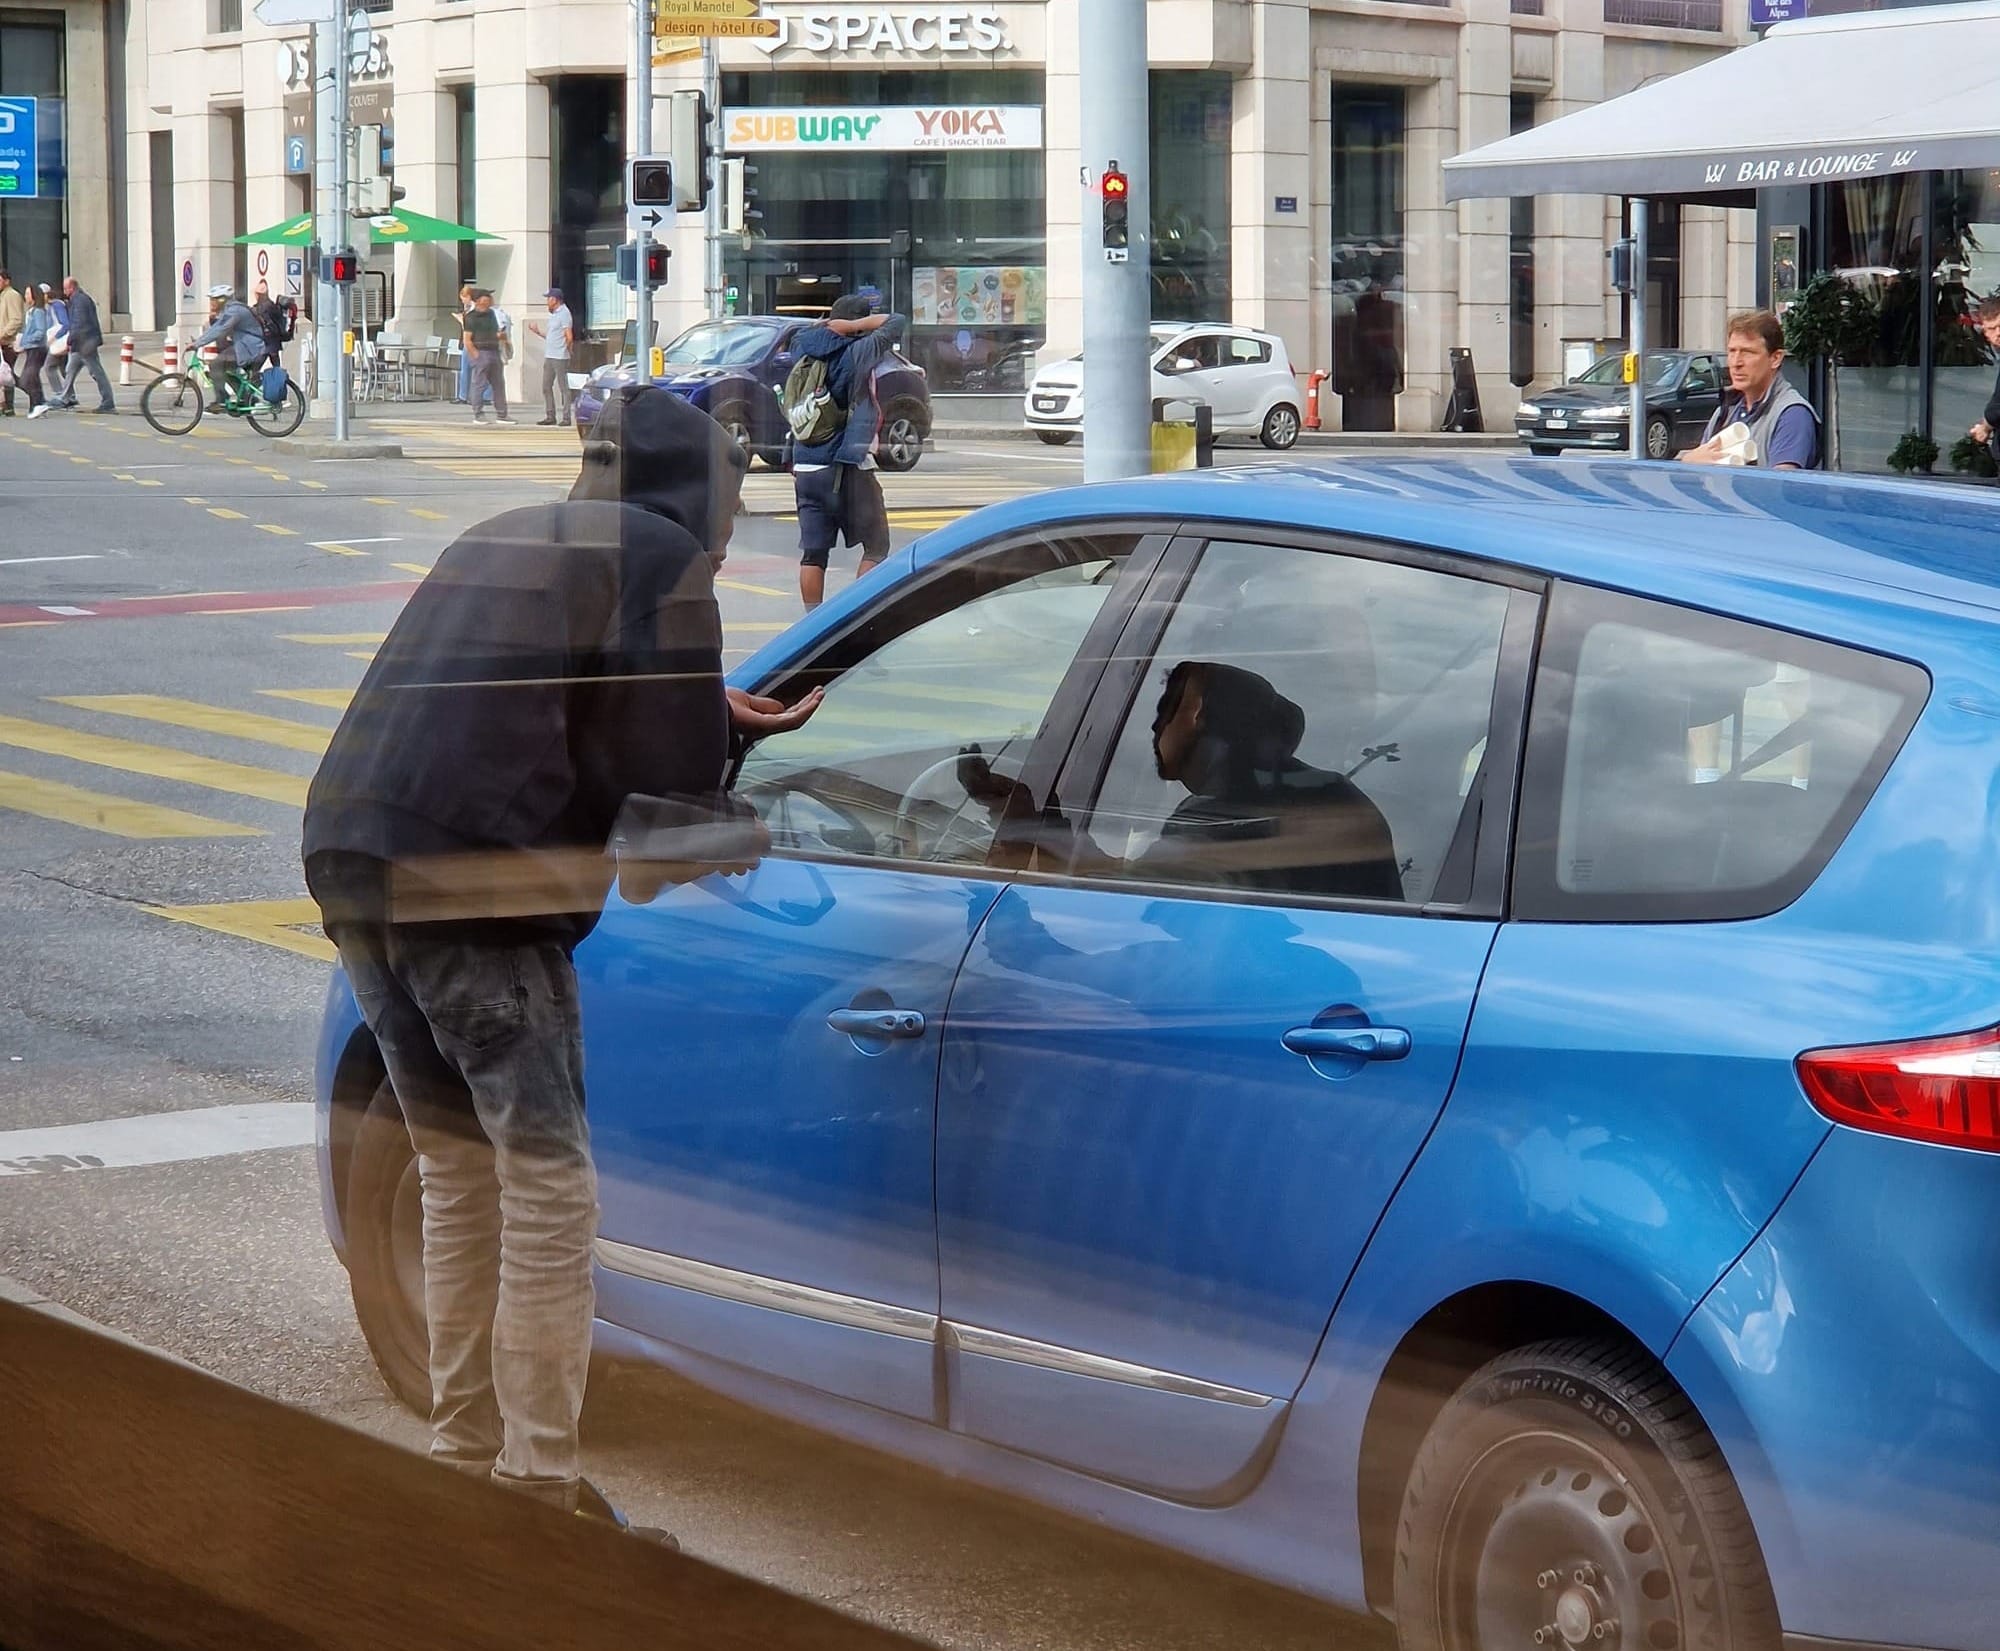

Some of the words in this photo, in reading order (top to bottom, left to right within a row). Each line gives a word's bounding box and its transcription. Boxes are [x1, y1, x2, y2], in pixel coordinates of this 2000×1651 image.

[664, 0, 690, 15] Royal
[693, 0, 735, 13] Manotel
[1769, 7, 1789, 19] Alpes
[664, 21, 704, 35] design
[712, 21, 745, 34] hôtel
[750, 21, 765, 34] f6
[729, 113, 882, 142] SUBWAY
[914, 109, 1005, 135] YOKA
[948, 138, 979, 146] SNACK
[986, 138, 1007, 146] BAR
[1737, 160, 1781, 182] BAR
[1784, 161, 1794, 177] &
[1799, 152, 1883, 178] LOUNGE
[1580, 1393, 1632, 1437] S130
